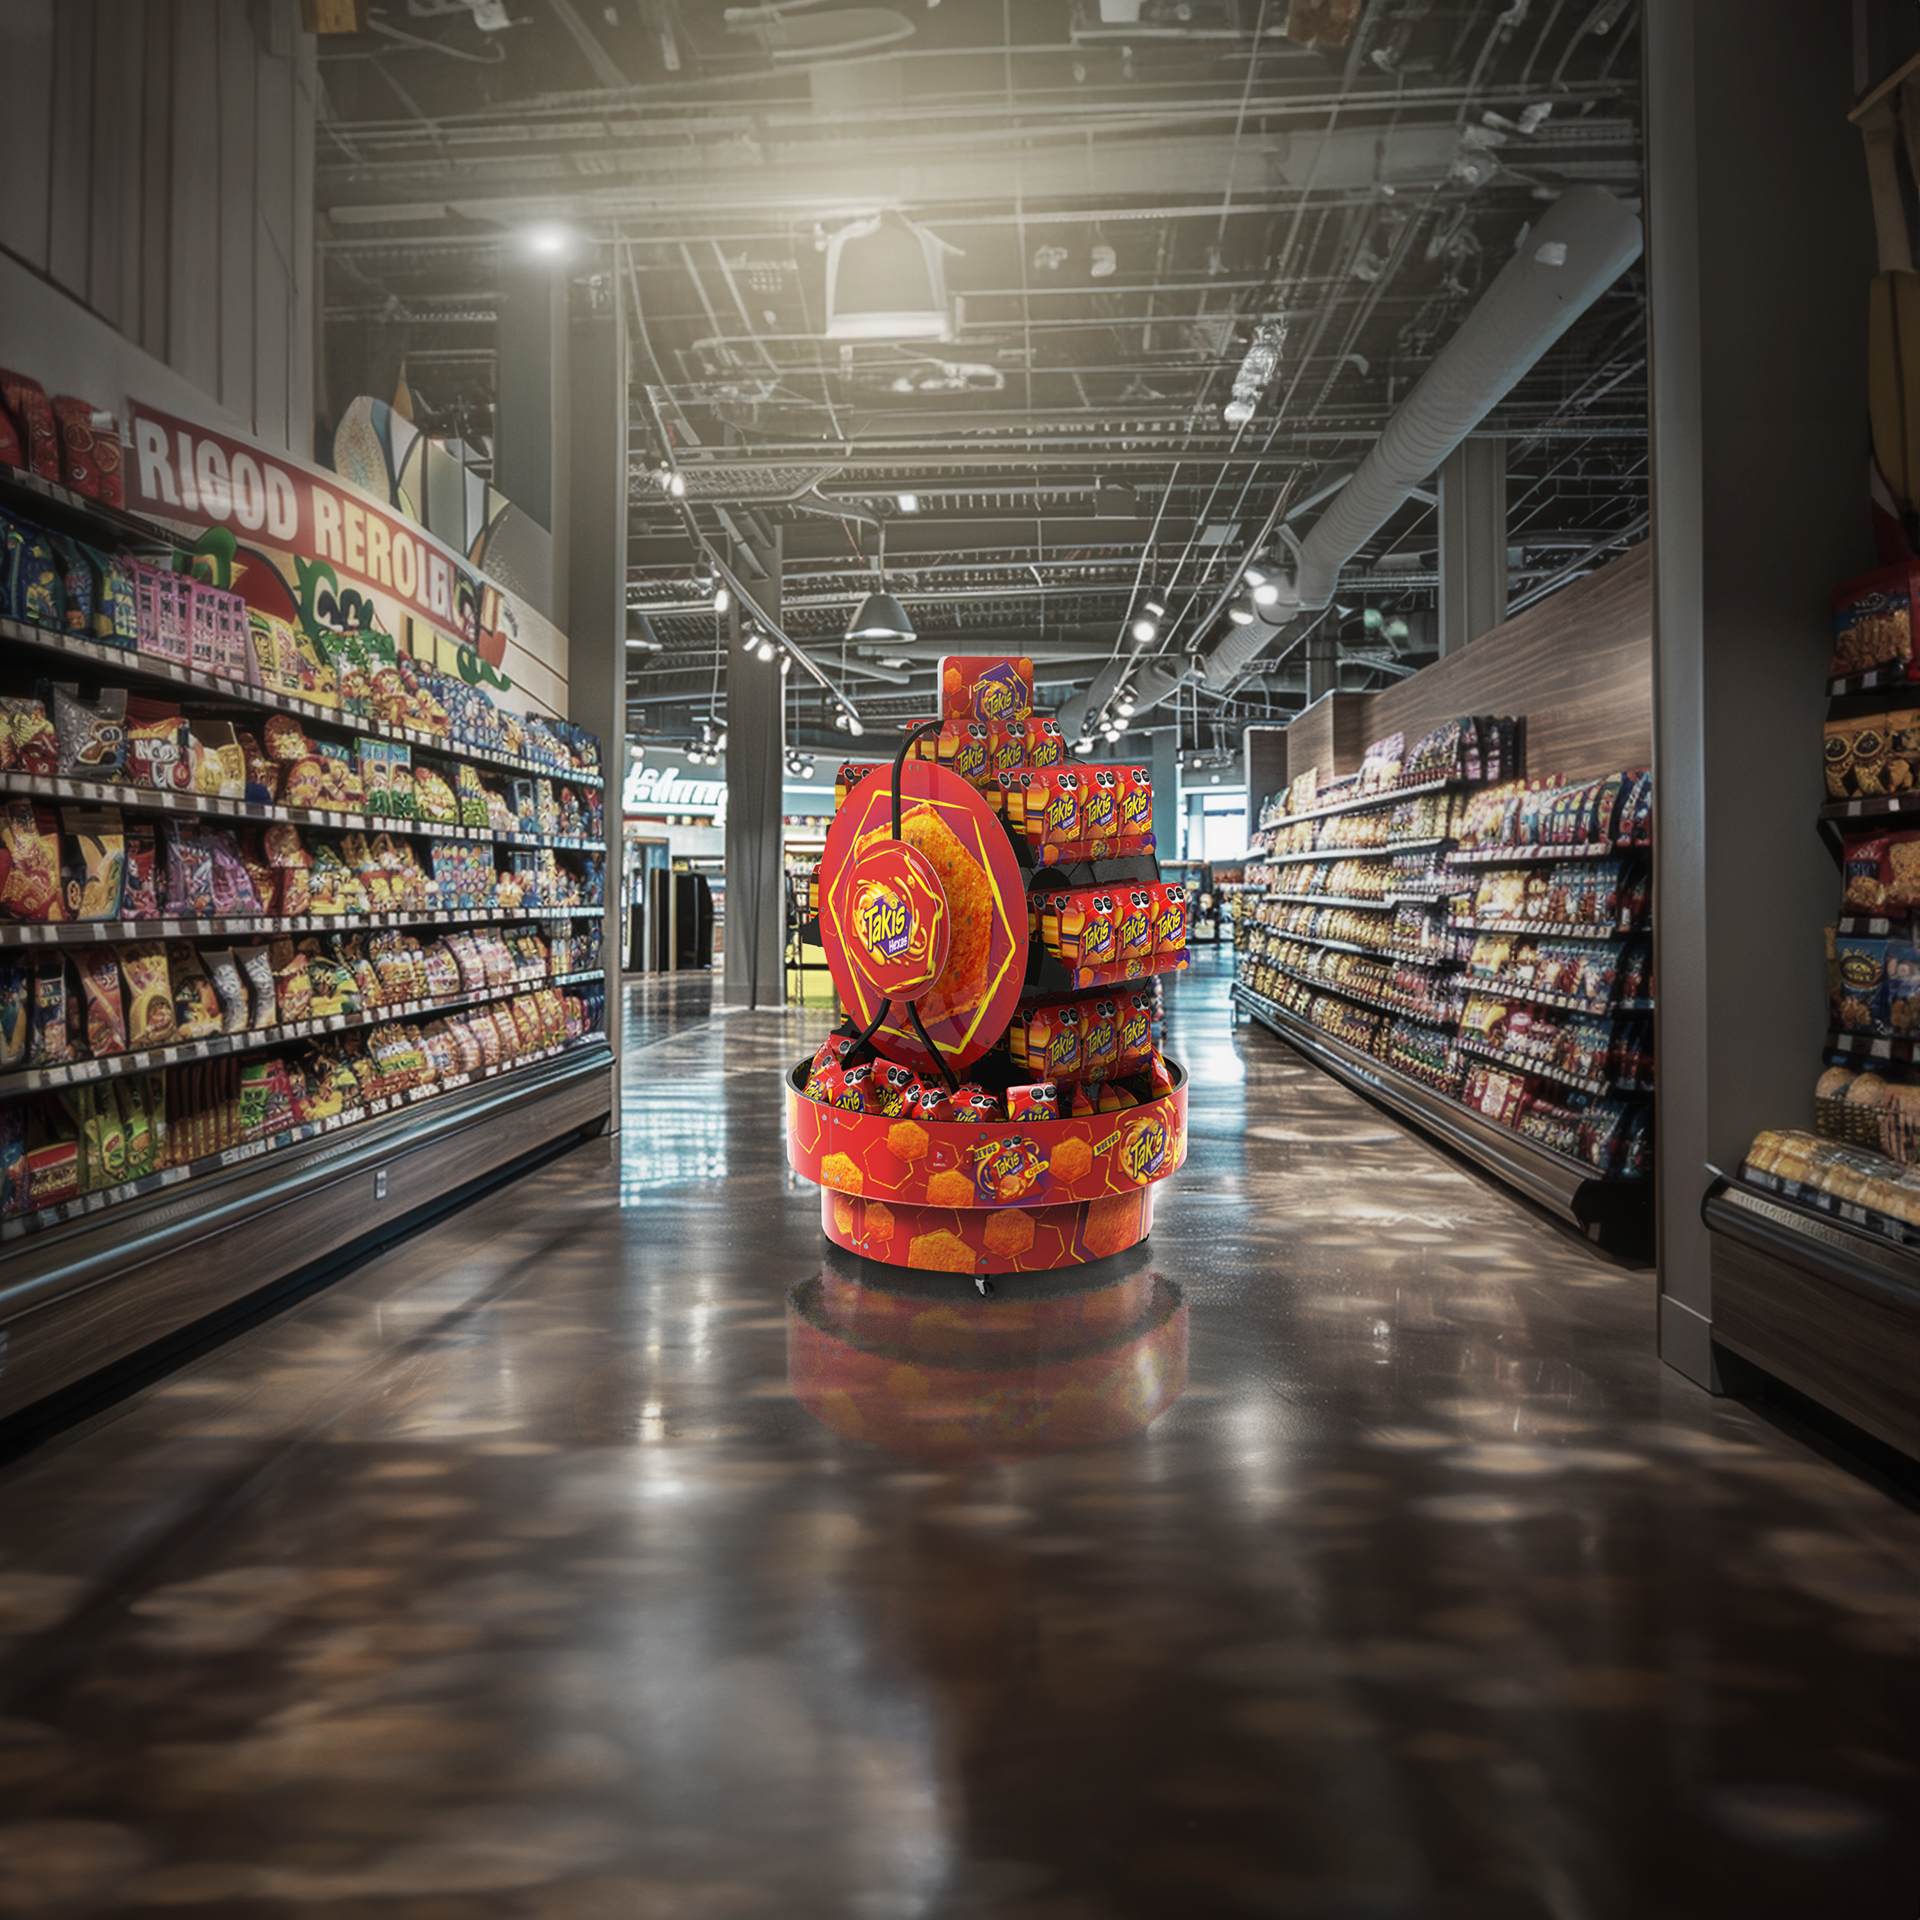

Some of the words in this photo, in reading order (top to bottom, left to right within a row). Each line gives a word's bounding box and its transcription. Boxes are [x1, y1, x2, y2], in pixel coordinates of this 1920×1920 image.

[135, 417, 298, 541] RIGOD
[956, 747, 984, 777] Takis
[995, 745, 1021, 769] Takis
[1033, 743, 1057, 768] Takis
[1047, 799, 1074, 831] Takis
[1085, 796, 1112, 828] Takis
[1122, 793, 1147, 824] Takis
[864, 904, 906, 951] Takis
[1082, 921, 1109, 956] Takis
[1120, 915, 1146, 950] Takis
[1156, 911, 1181, 944] Takis
[888, 935, 908, 953] Hexas
[1048, 1031, 1075, 1068] Takis
[1086, 1025, 1111, 1059] Takis
[1122, 1018, 1146, 1051] Takis
[975, 1144, 998, 1160] UEVOS
[993, 1152, 1020, 1179] Takis
